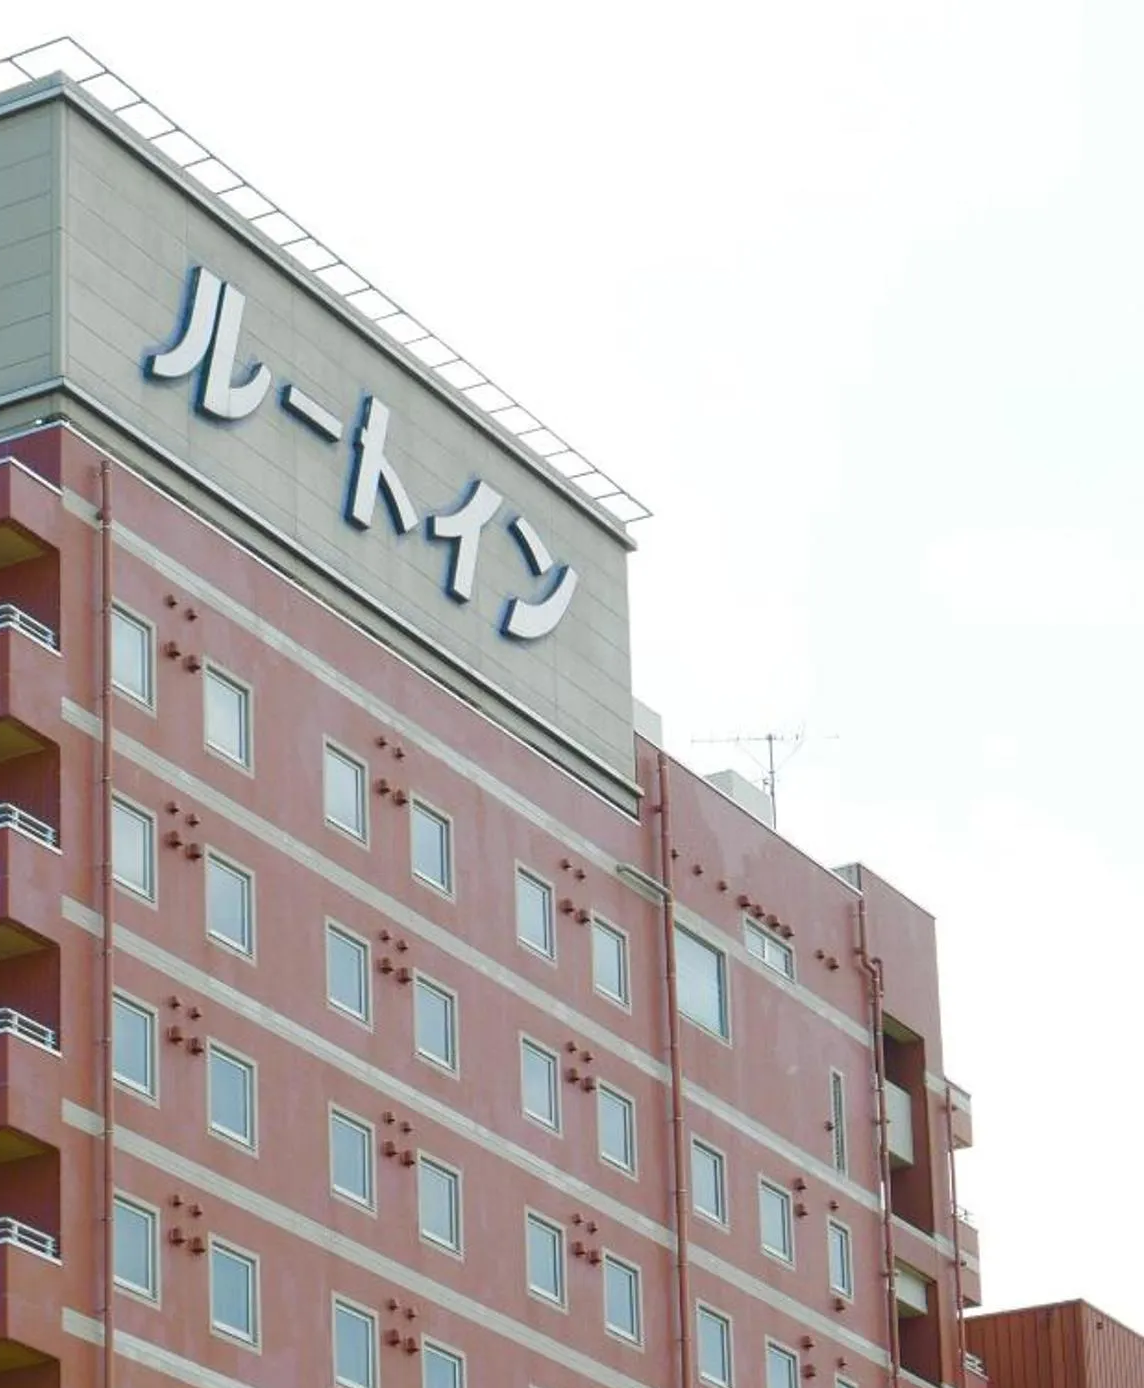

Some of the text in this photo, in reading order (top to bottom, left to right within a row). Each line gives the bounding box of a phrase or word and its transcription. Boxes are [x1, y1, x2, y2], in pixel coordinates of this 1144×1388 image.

[144, 265, 579, 640] ルートイン
